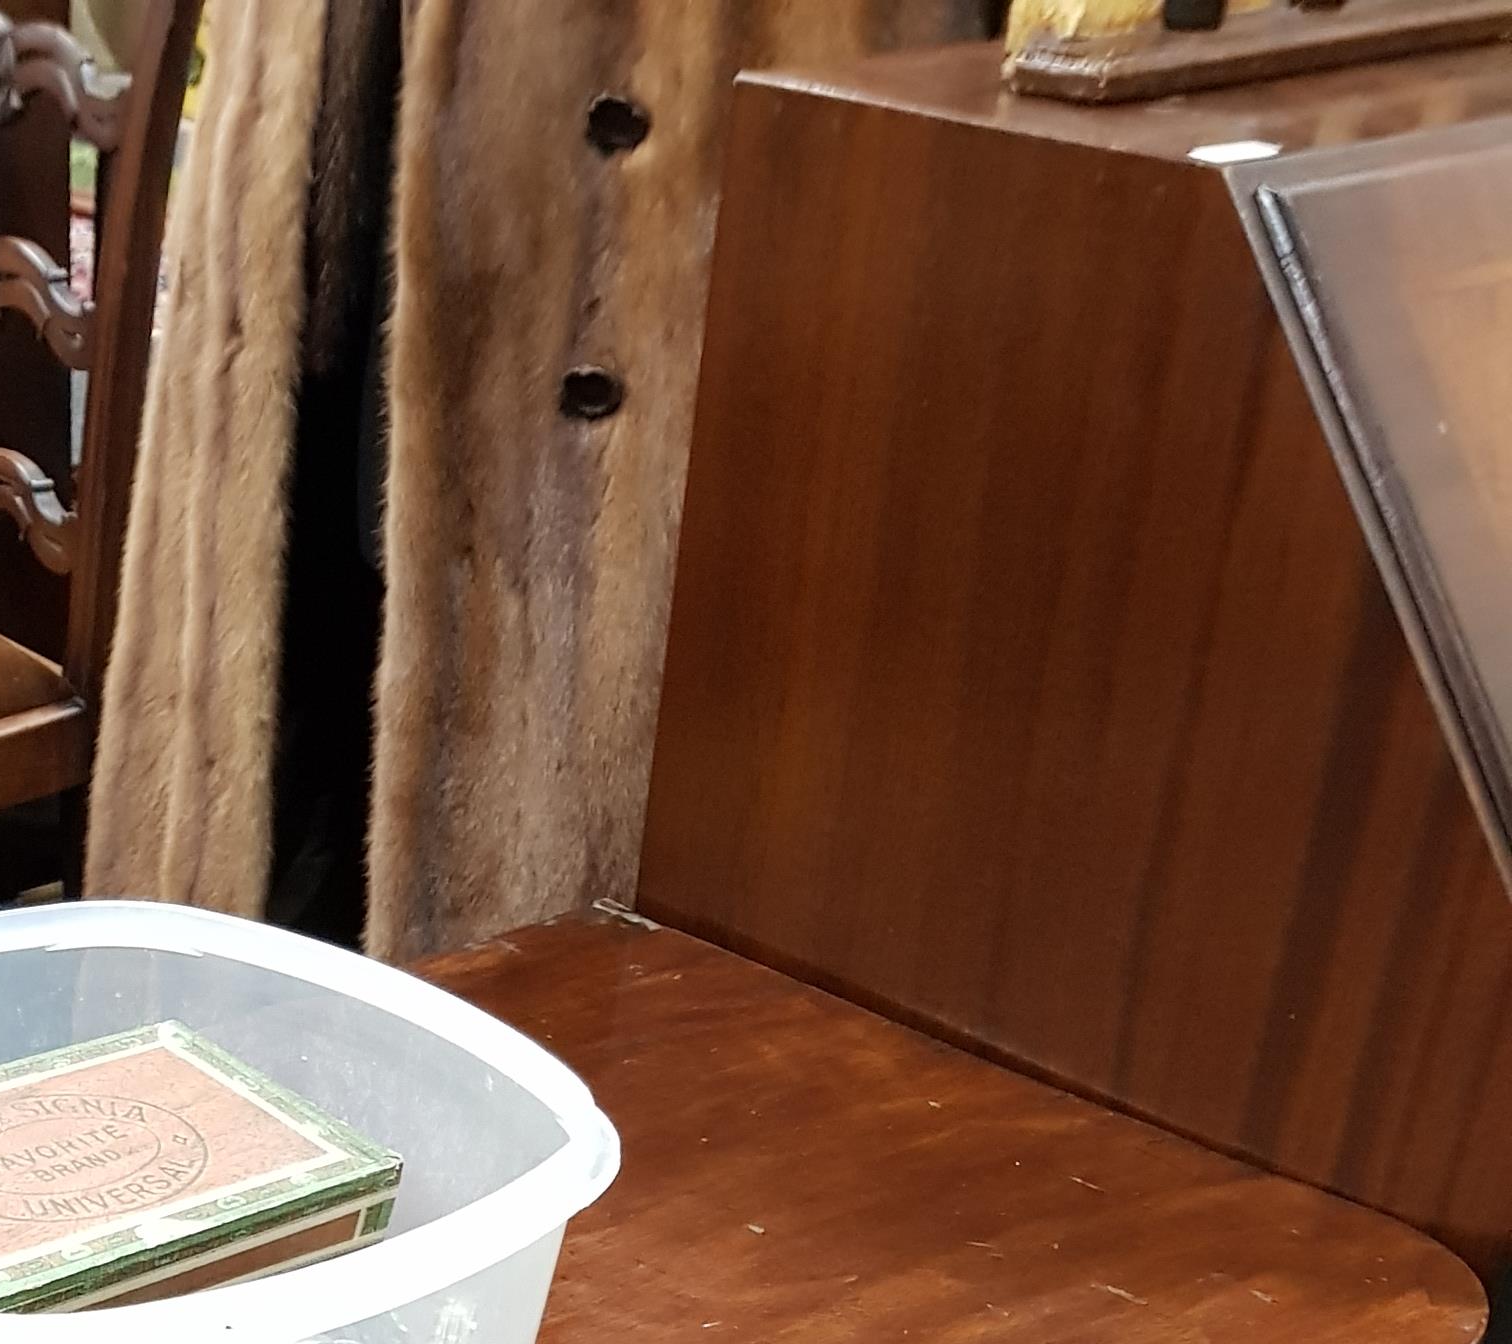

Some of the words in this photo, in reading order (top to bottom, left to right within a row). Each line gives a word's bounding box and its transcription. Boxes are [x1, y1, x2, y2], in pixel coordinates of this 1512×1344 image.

[10, 1098, 147, 1123] SIGNIA
[31, 1150, 122, 1182] BRAND
[23, 1158, 198, 1217] UNIVERSAL
